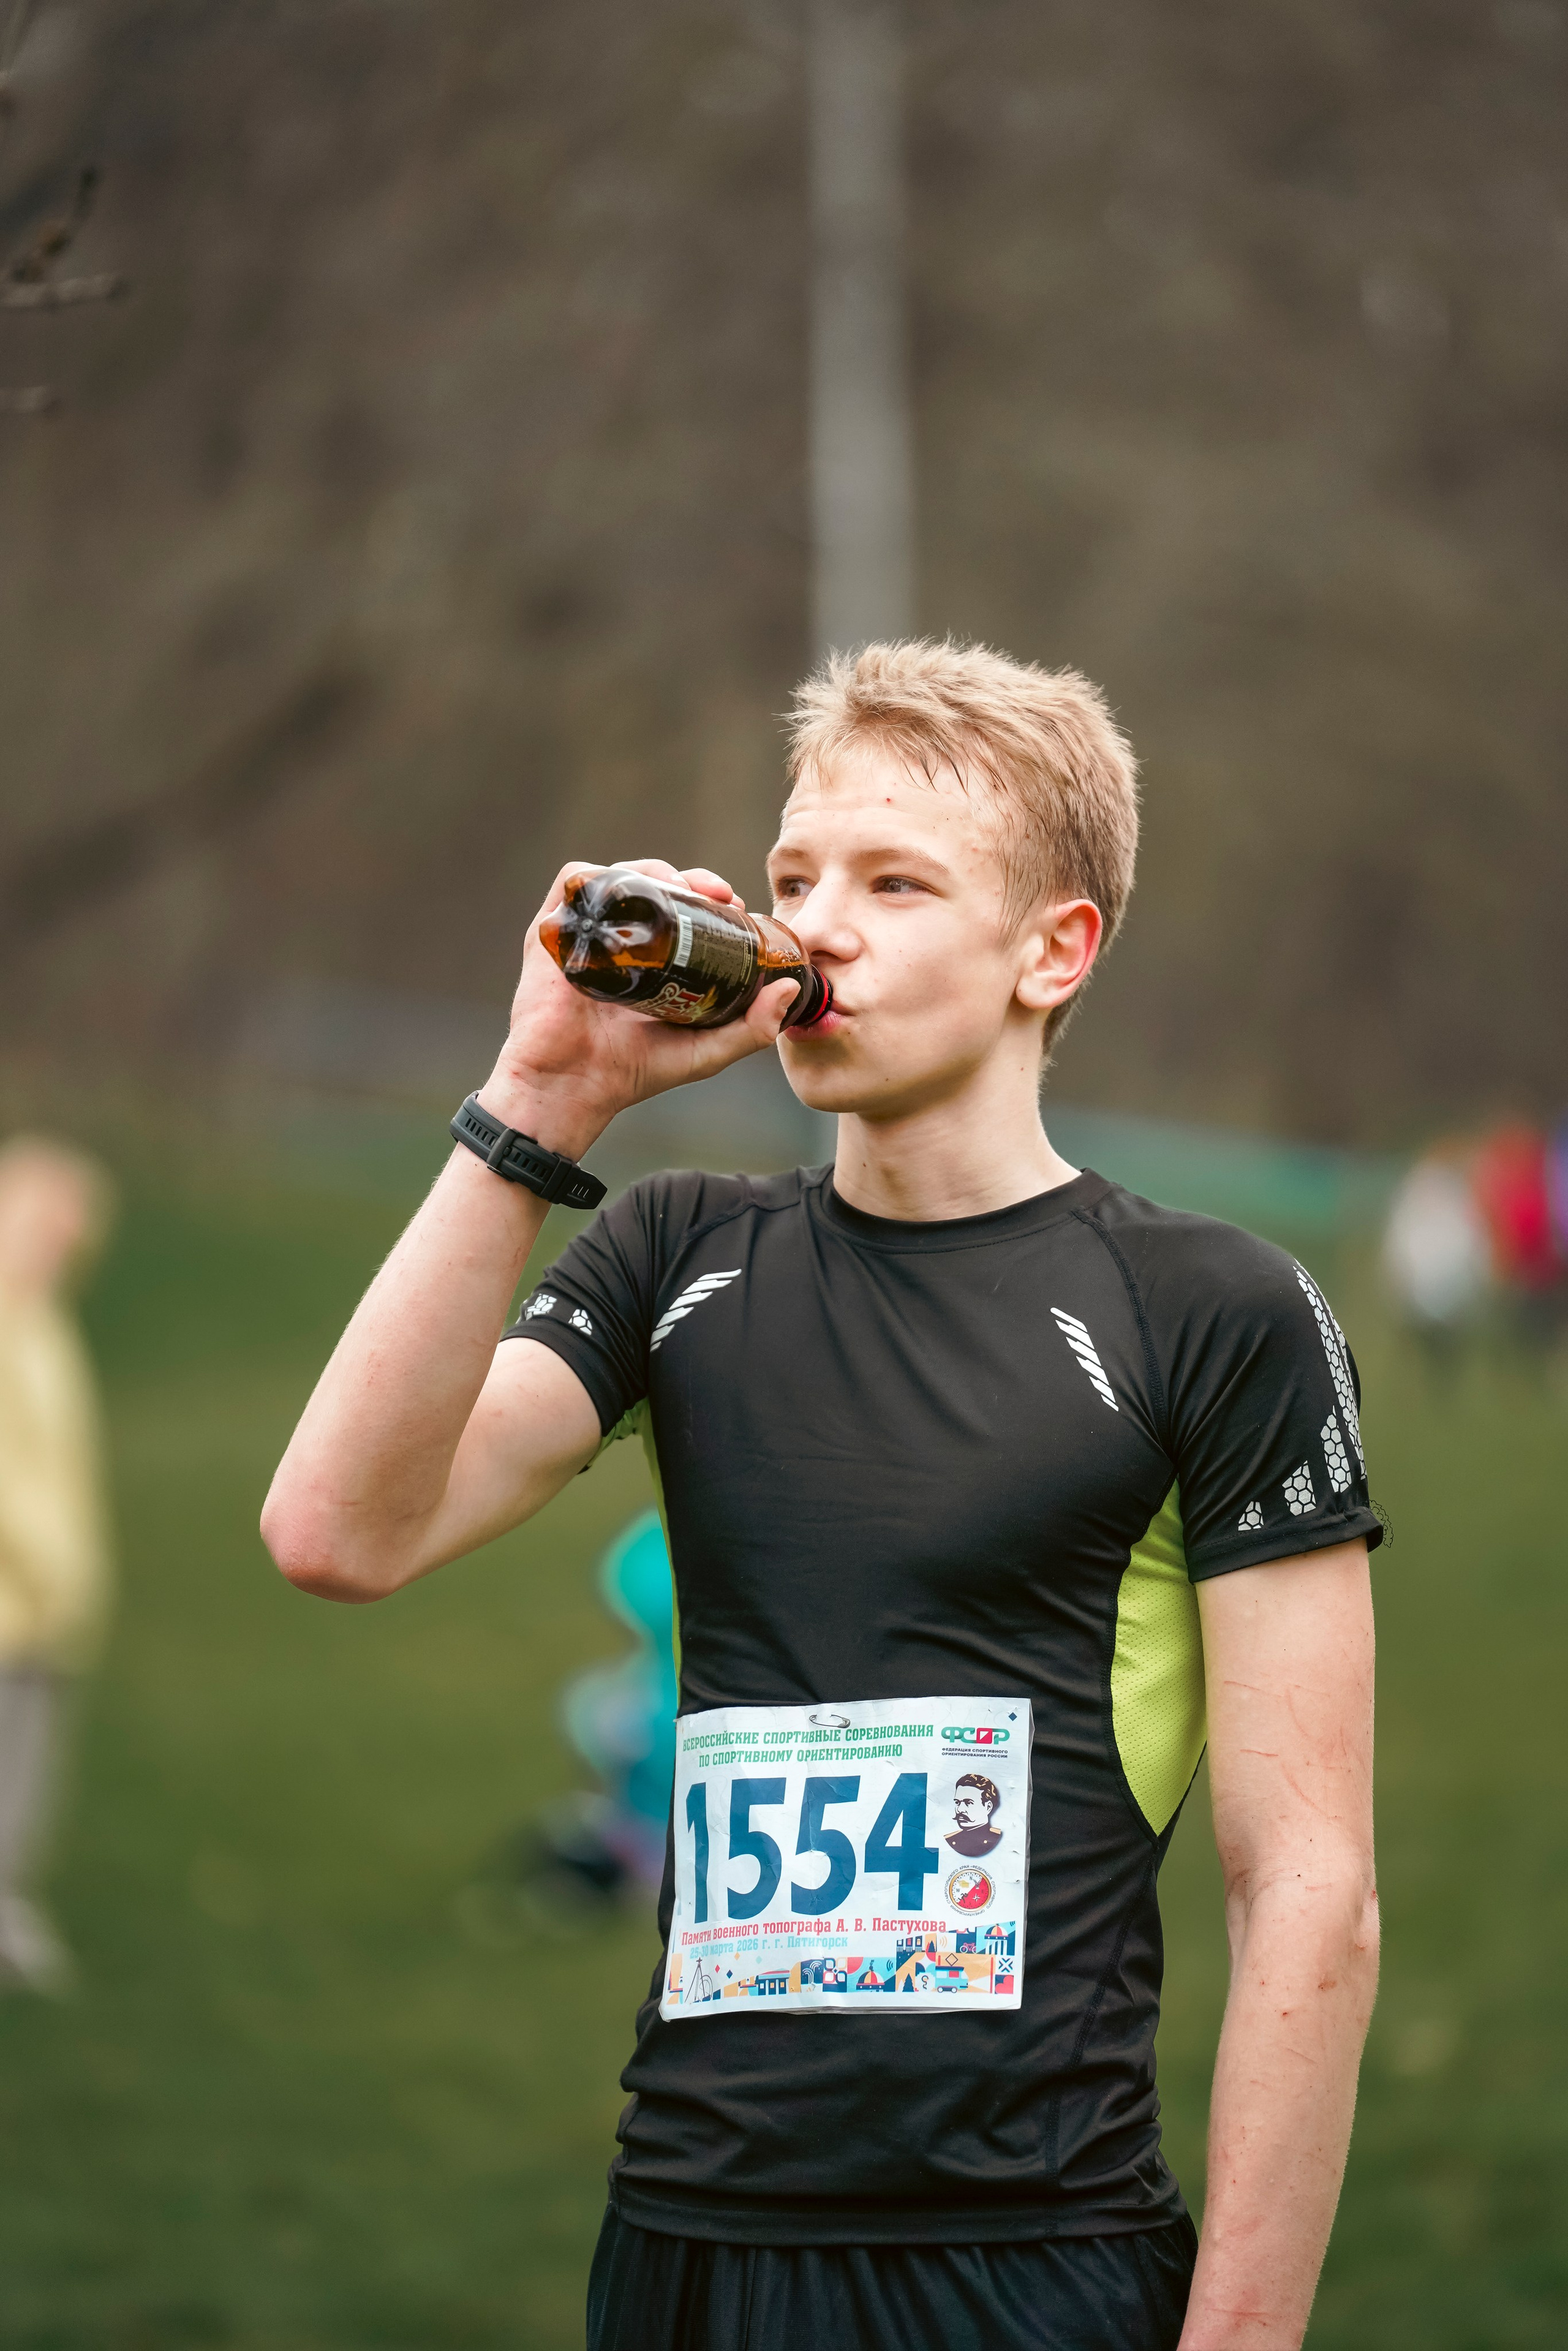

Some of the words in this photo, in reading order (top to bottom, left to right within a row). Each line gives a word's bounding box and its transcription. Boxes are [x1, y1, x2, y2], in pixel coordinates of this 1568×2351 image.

[683, 1730, 759, 1751] ВСЕРОССИЙСКИЕ
[763, 1729, 841, 1744] СПОРТИВНЫЕ
[845, 1724, 933, 1742] СОРЕВНОВАНИЯ
[699, 1754, 710, 1767] ПО
[712, 1750, 793, 1765] СПОРТИВНОМУ
[797, 1744, 903, 1762] ОРИЕНТИРОВАНИЮ
[685, 1773, 939, 1923] 1554
[972, 1865, 992, 1879] ФЕДЕРАЦИЯ
[944, 1868, 959, 1904] СТАВРОПОЛЬСКОГО
[986, 1881, 996, 1909] СПОРТИВНОГО
[950, 1904, 985, 1917] ОРИЕНТИРОВАНИЯ
[681, 1930, 711, 1945] Памяти
[713, 1923, 759, 1940] военного
[763, 1918, 831, 1936] топографа
[836, 1919, 848, 1932] А.
[854, 1919, 866, 1931] В.
[872, 1918, 946, 1934] Пастухова
[690, 1947, 709, 1959] 25-30
[710, 1943, 733, 1957] марта
[737, 1939, 758, 1952] 2026
[762, 1939, 770, 1949] г.
[775, 1938, 783, 1948] г.
[787, 1936, 848, 1950] Пятигорск
